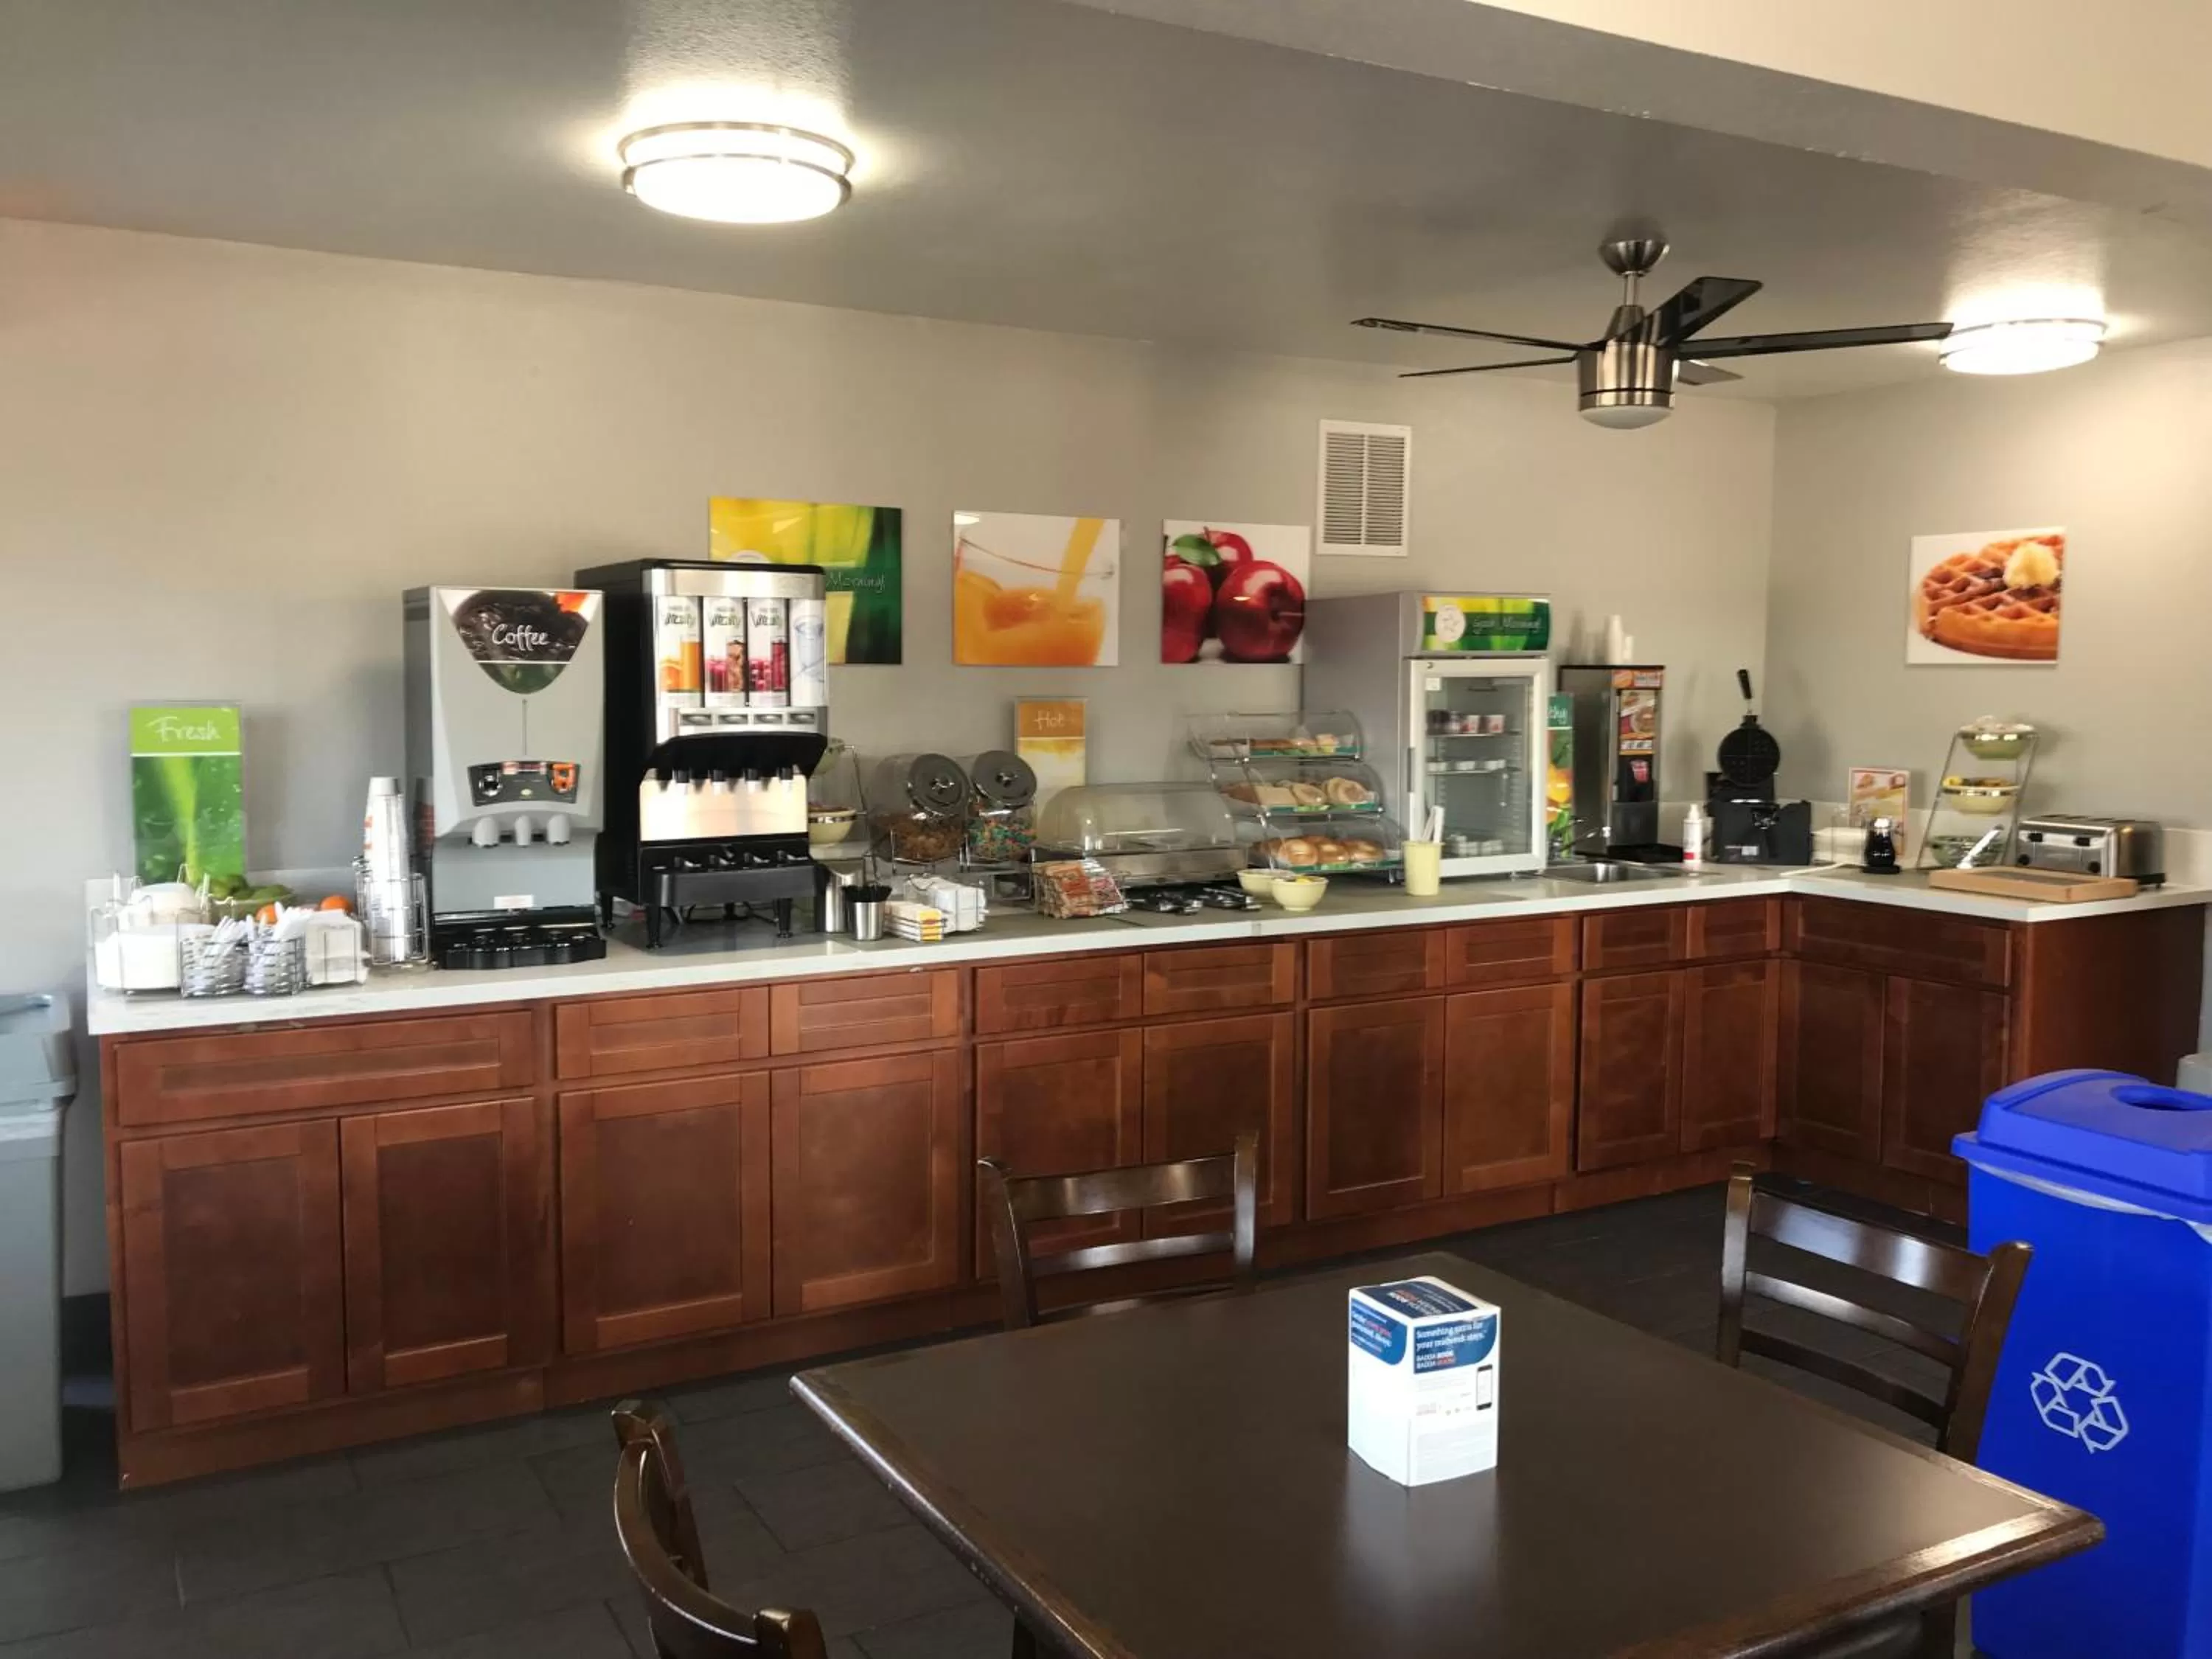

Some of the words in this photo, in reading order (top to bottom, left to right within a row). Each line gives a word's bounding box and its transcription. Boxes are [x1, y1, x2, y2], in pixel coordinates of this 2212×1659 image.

[492, 623, 550, 651] Coffee
[145, 716, 222, 744] Fresh
[1032, 710, 1065, 731] Hot
